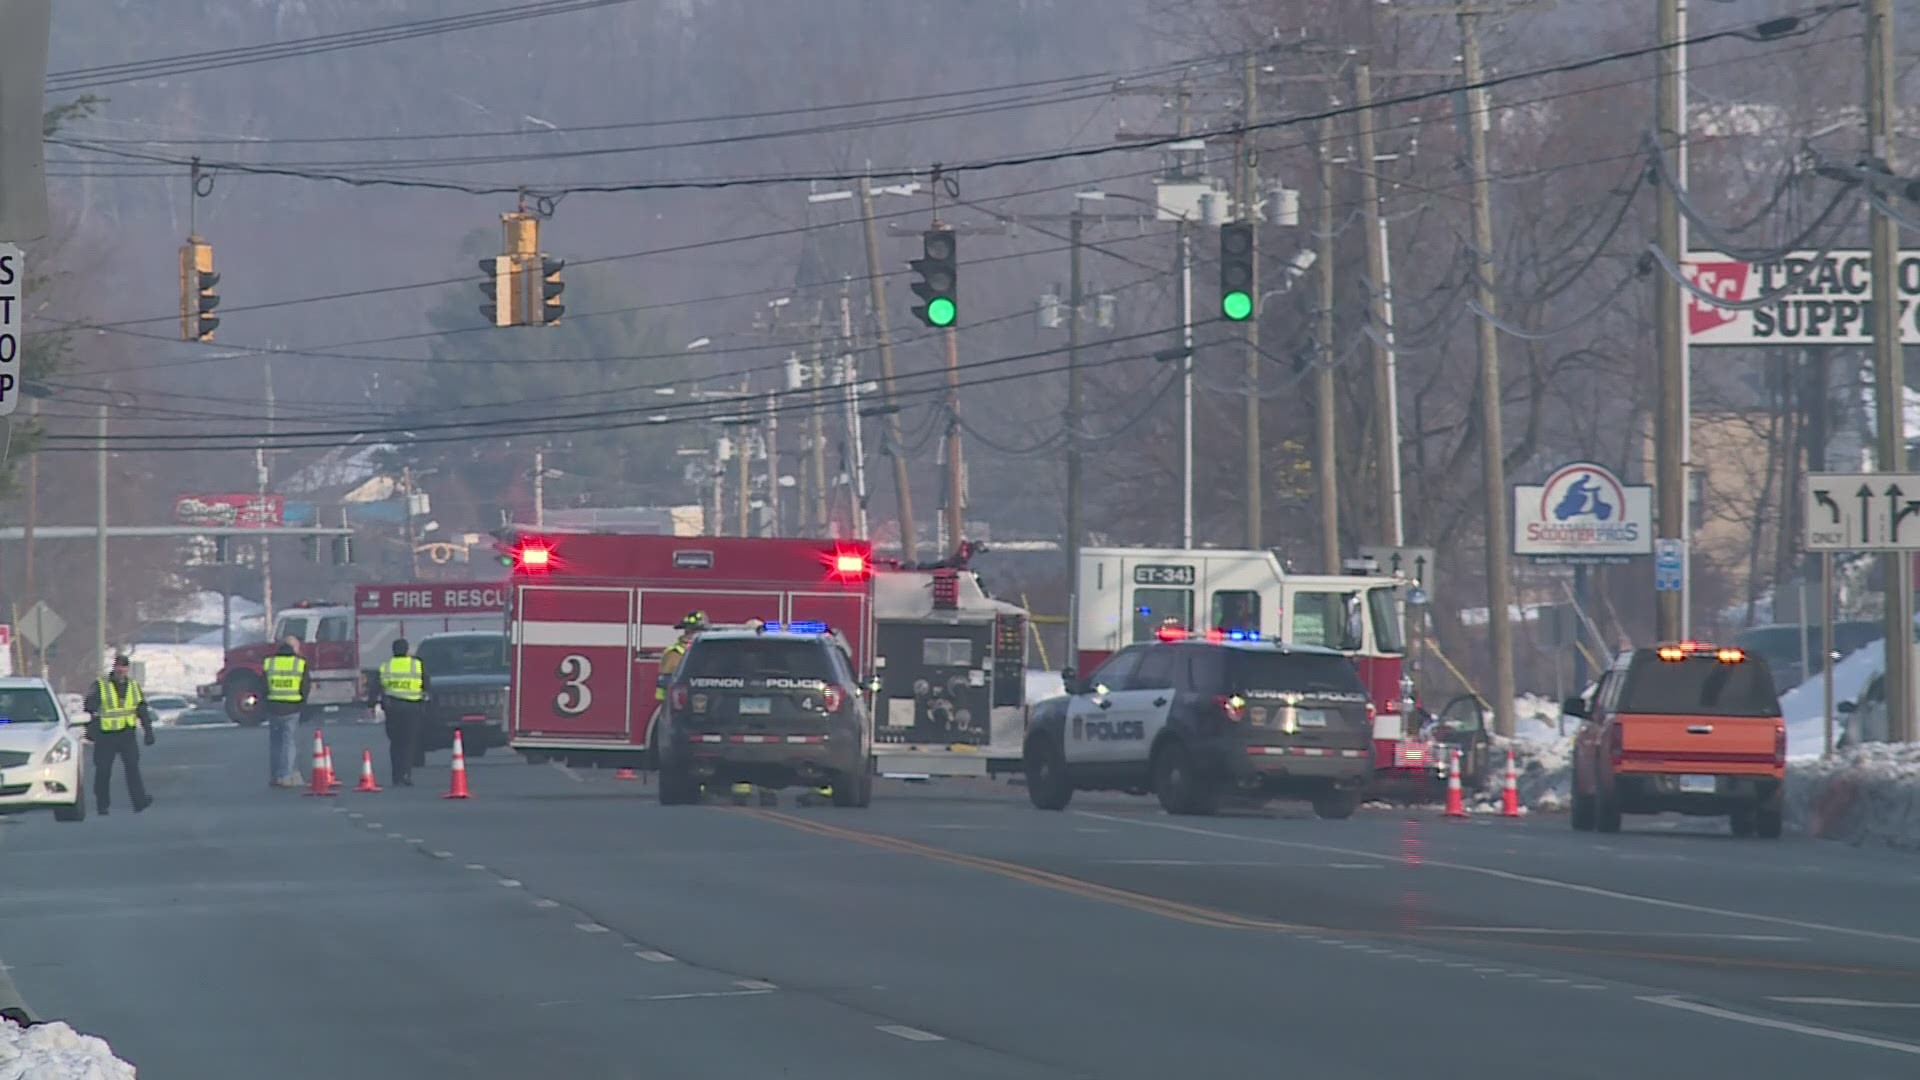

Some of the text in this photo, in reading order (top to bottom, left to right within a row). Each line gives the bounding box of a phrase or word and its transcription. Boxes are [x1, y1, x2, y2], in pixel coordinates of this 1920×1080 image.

[1752, 257, 1920, 295] TRACO
[0, 255, 16, 400] STOP
[1136, 567, 1193, 583] ET-341
[392, 588, 505, 608] FIRE RESCU
[556, 654, 592, 715] 3
[690, 678, 744, 688] VERNON
[802, 697, 812, 710] 4
[1086, 721, 1144, 741] POLICE
